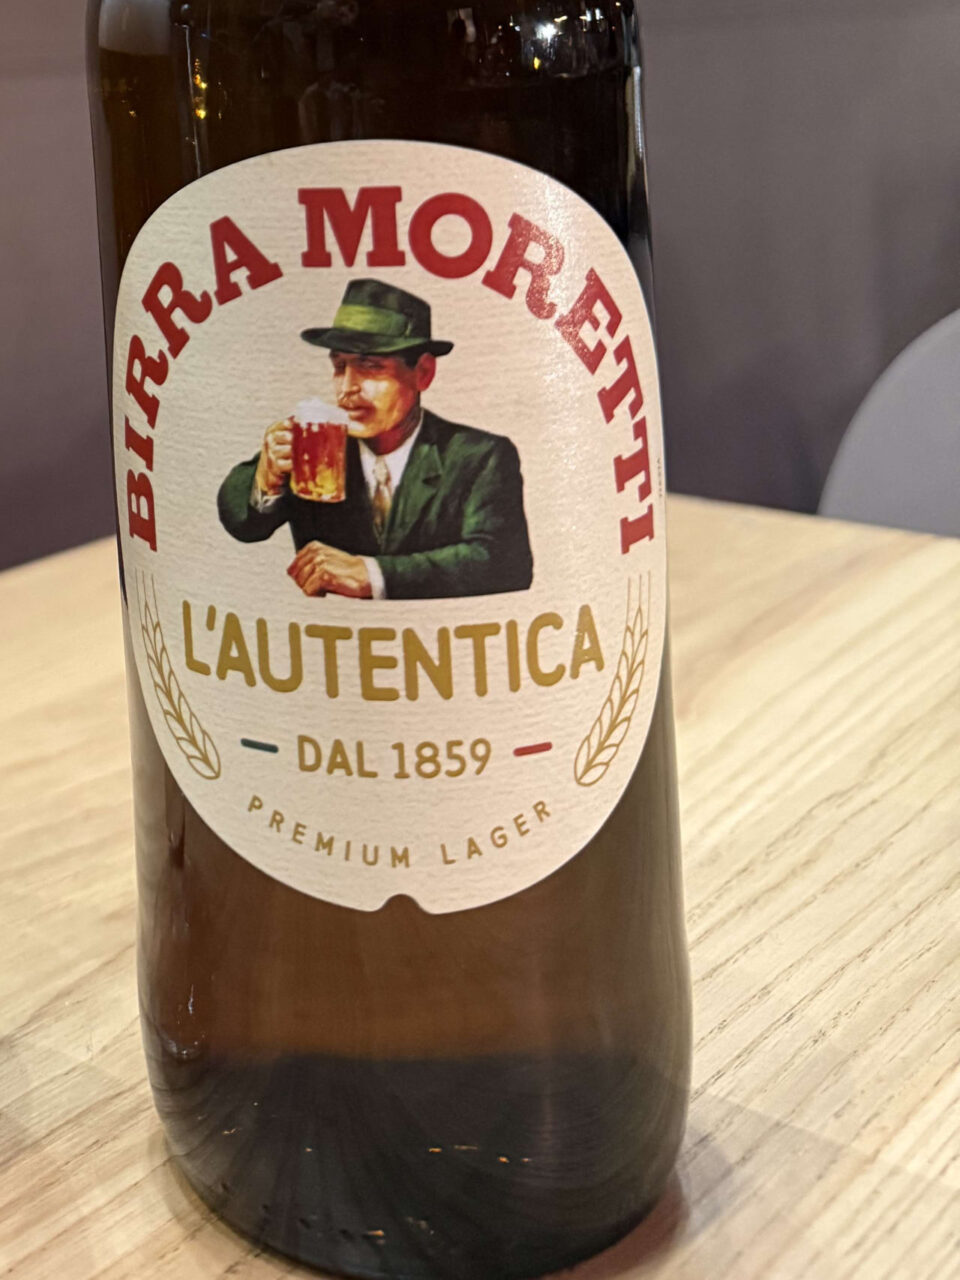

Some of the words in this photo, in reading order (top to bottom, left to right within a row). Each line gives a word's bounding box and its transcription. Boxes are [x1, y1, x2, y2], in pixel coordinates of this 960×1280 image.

[124, 215, 284, 553] BIRRA
[297, 185, 656, 556] MORETTI
[181, 599, 605, 702] L'AUTENTICA
[297, 734, 379, 779] DAL
[391, 737, 492, 779] 1859
[246, 794, 411, 869] PREMIUM
[440, 799, 553, 866] LAGER
